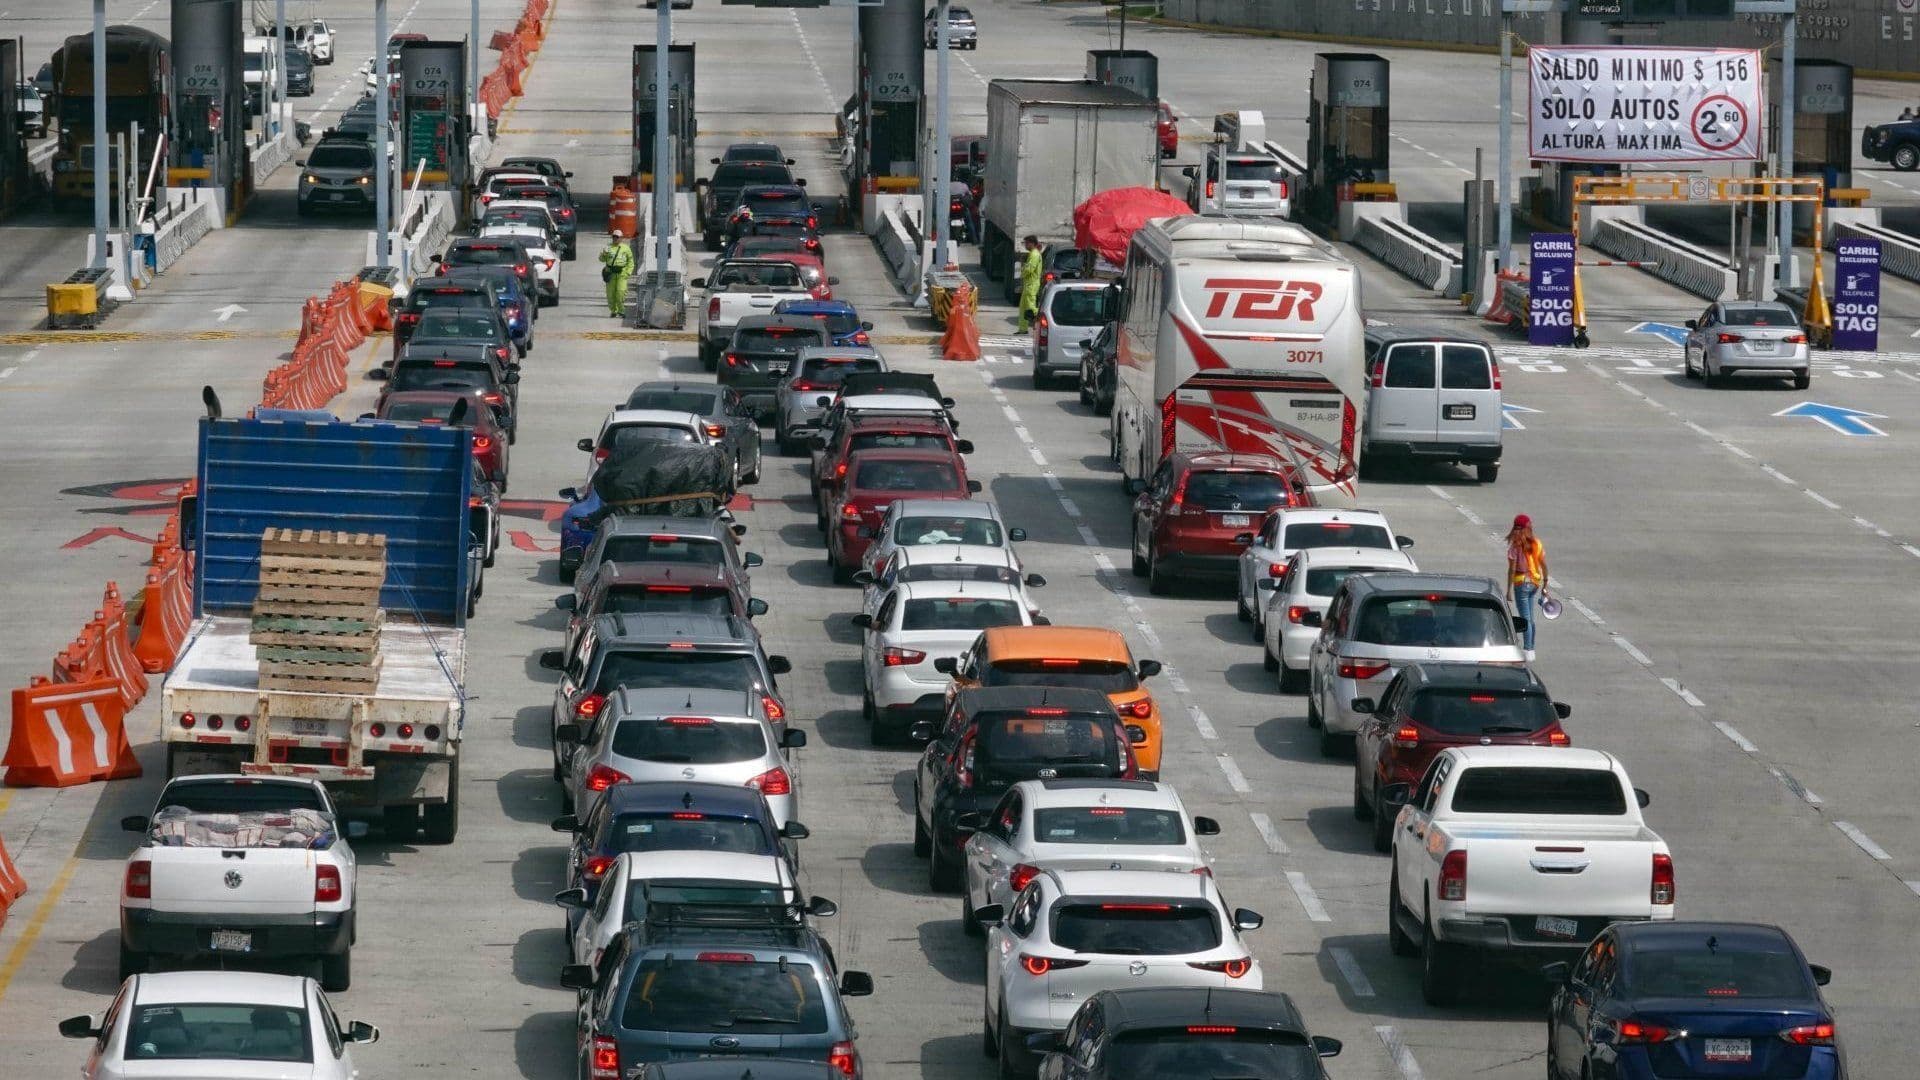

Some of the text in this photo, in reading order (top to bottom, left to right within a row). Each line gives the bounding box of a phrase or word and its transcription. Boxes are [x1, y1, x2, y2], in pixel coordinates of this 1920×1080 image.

[1744, 13, 1782, 23] PLAZA
[1808, 15, 1848, 27] COBRO
[1541, 57, 1748, 82] SALDO MINIMO $ 156
[187, 77, 219, 87] 074
[648, 83, 680, 92] 04
[1353, 80, 1371, 88] 074
[879, 85, 912, 95] 074
[1541, 98, 1680, 120] SOLO AUTOS
[1701, 110, 1740, 134] 2 60
[1541, 134, 1683, 150] ALTURA MAXIMA
[1534, 242, 1574, 250] CARRIL
[1840, 246, 1879, 255] CARRIL
[1204, 278, 1323, 321] TER
[1532, 299, 1573, 310] SOLO
[1836, 303, 1878, 315] SOLO
[1531, 311, 1573, 327] TAG
[1835, 316, 1877, 332] TAG
[1286, 350, 1323, 363] 3071
